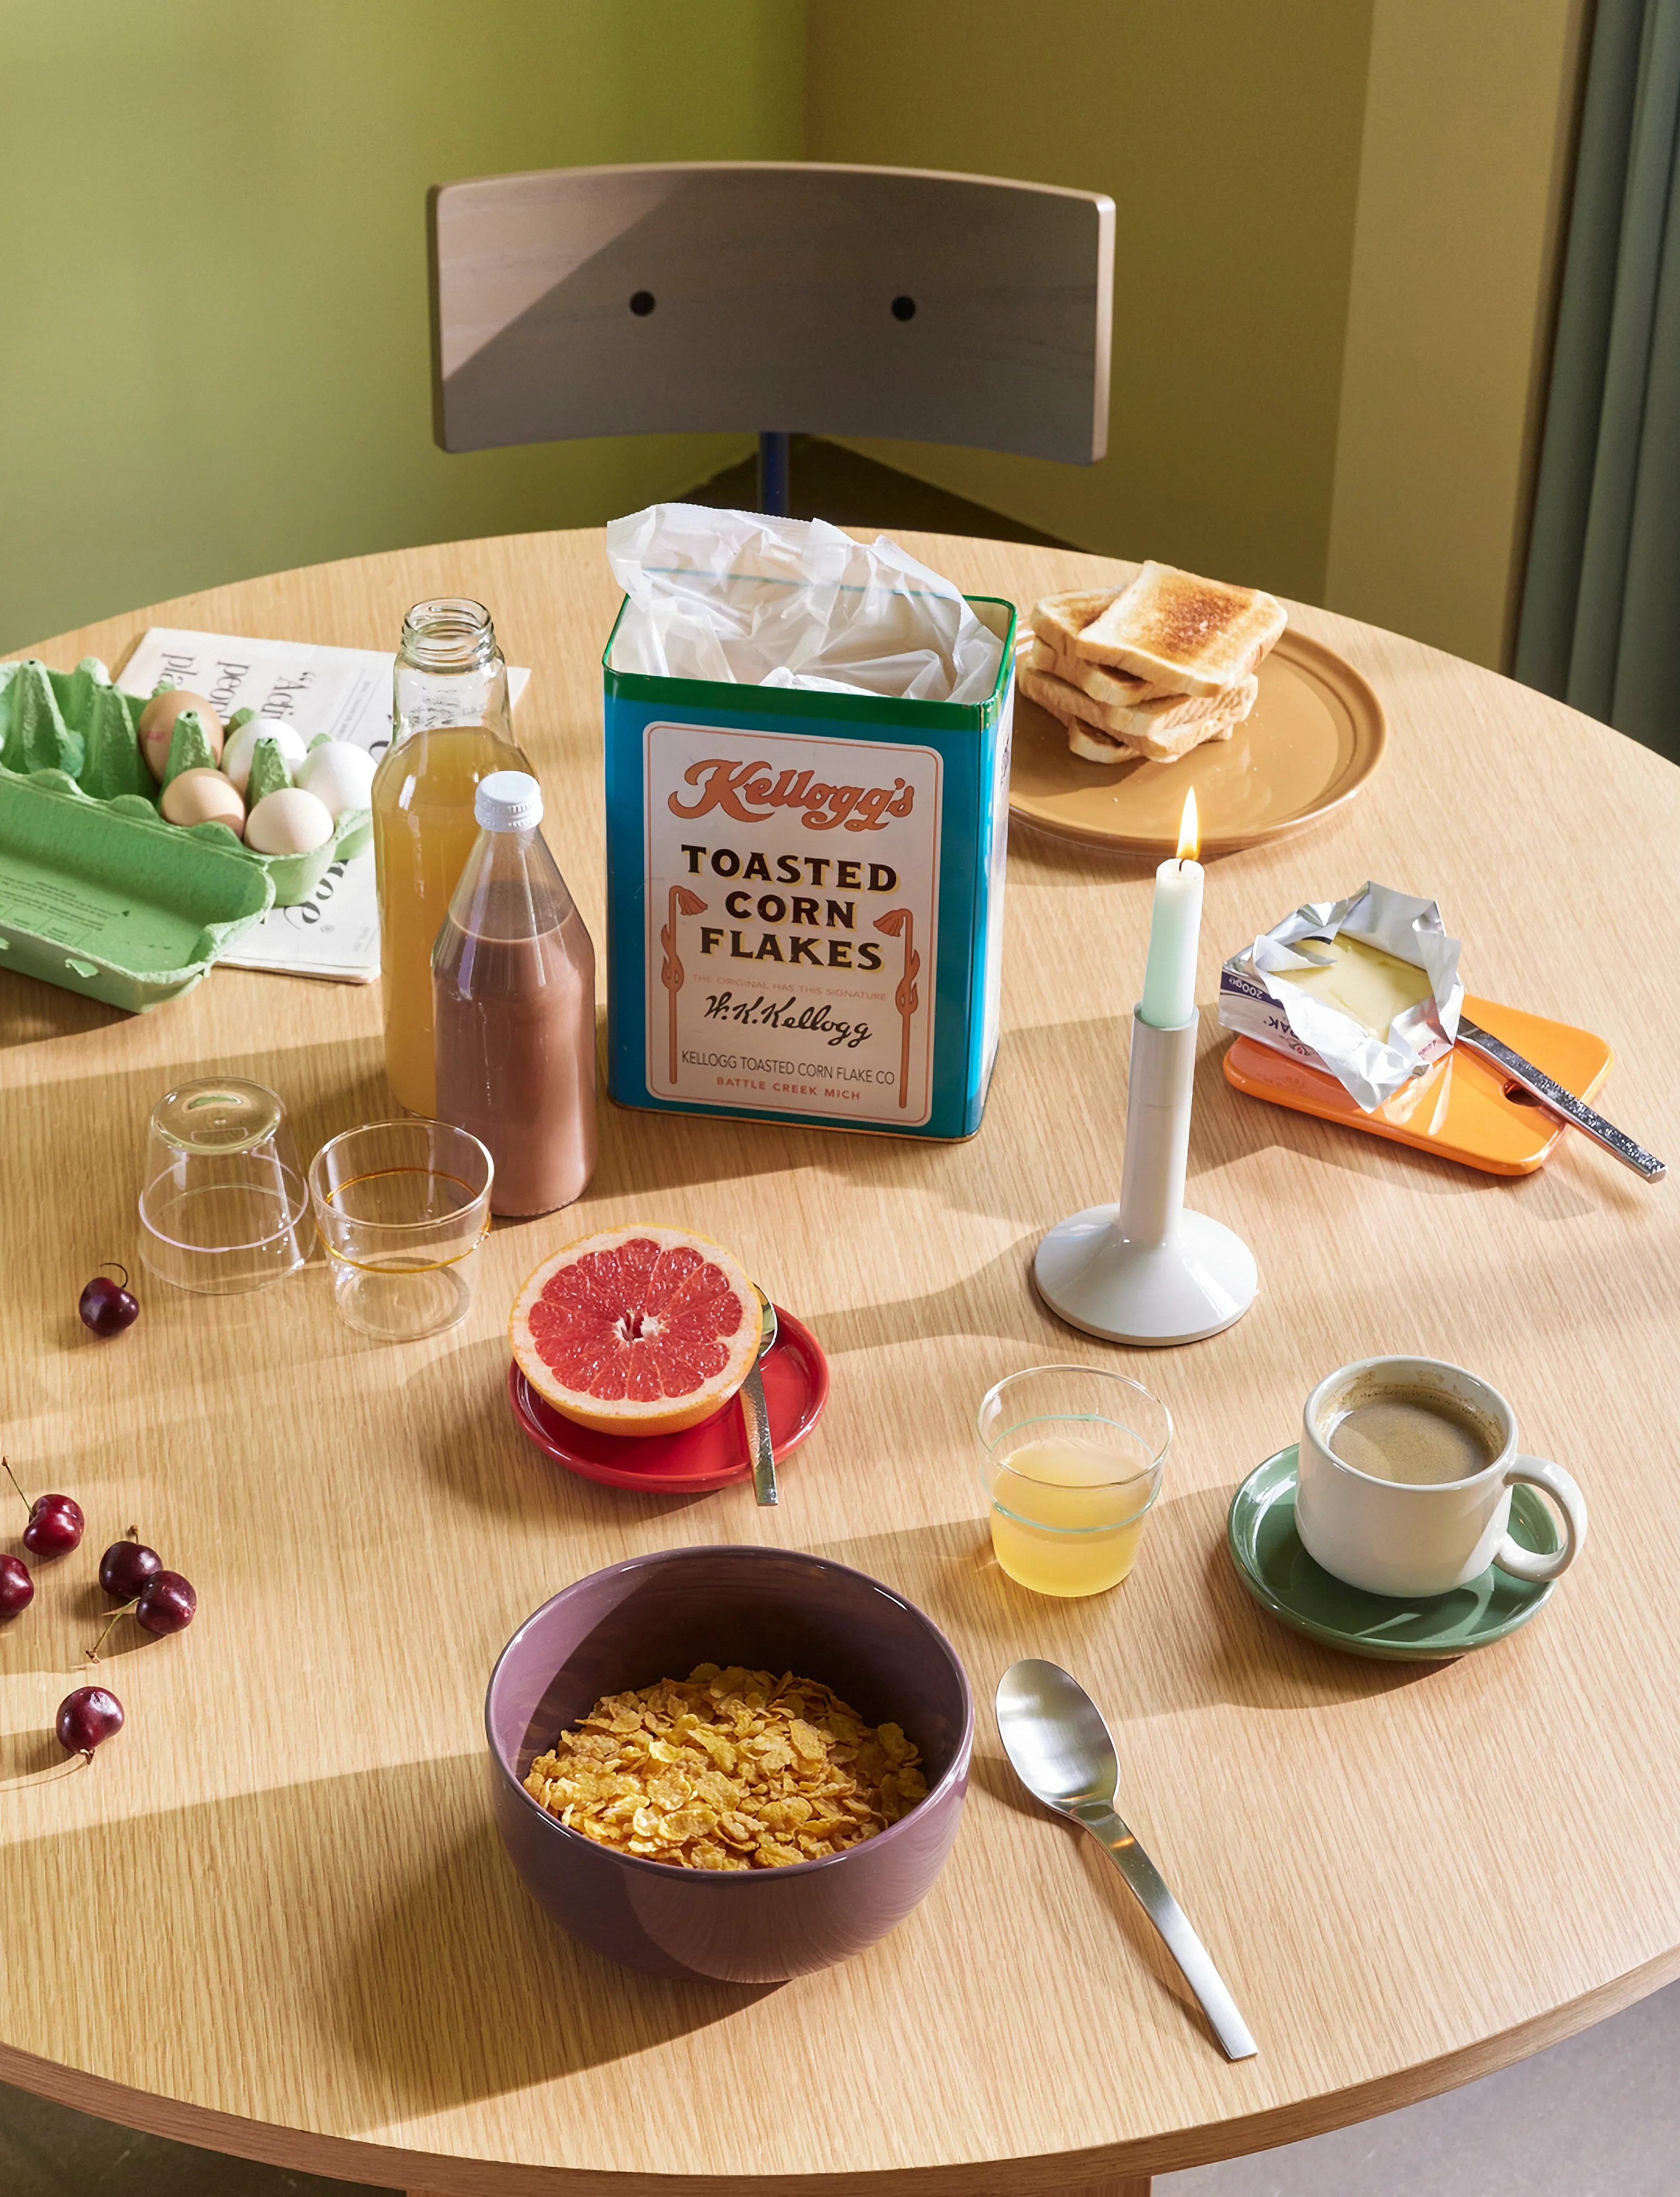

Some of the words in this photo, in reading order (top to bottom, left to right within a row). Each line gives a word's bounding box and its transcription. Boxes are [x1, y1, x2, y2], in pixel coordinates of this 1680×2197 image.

[668, 758, 914, 832] Kellogg's
[681, 844, 899, 893] TOASTED
[725, 891, 856, 931] CORN
[700, 926, 884, 972] FLAKES
[693, 973, 712, 984] THE
[717, 976, 768, 990] ORIGINAL
[772, 983, 795, 993] HAS
[799, 985, 823, 995] THIS
[826, 988, 887, 1001] SIGNATURE
[682, 1050, 737, 1069] KELLOGG
[740, 1057, 795, 1074] TOASTED
[798, 1062, 833, 1079] CORN
[836, 1067, 873, 1083] FLAKE
[876, 1071, 895, 1085] CO
[716, 1076, 766, 1090] BATTLE
[773, 1082, 818, 1096] CREEK
[824, 1088, 860, 1100] MICH
